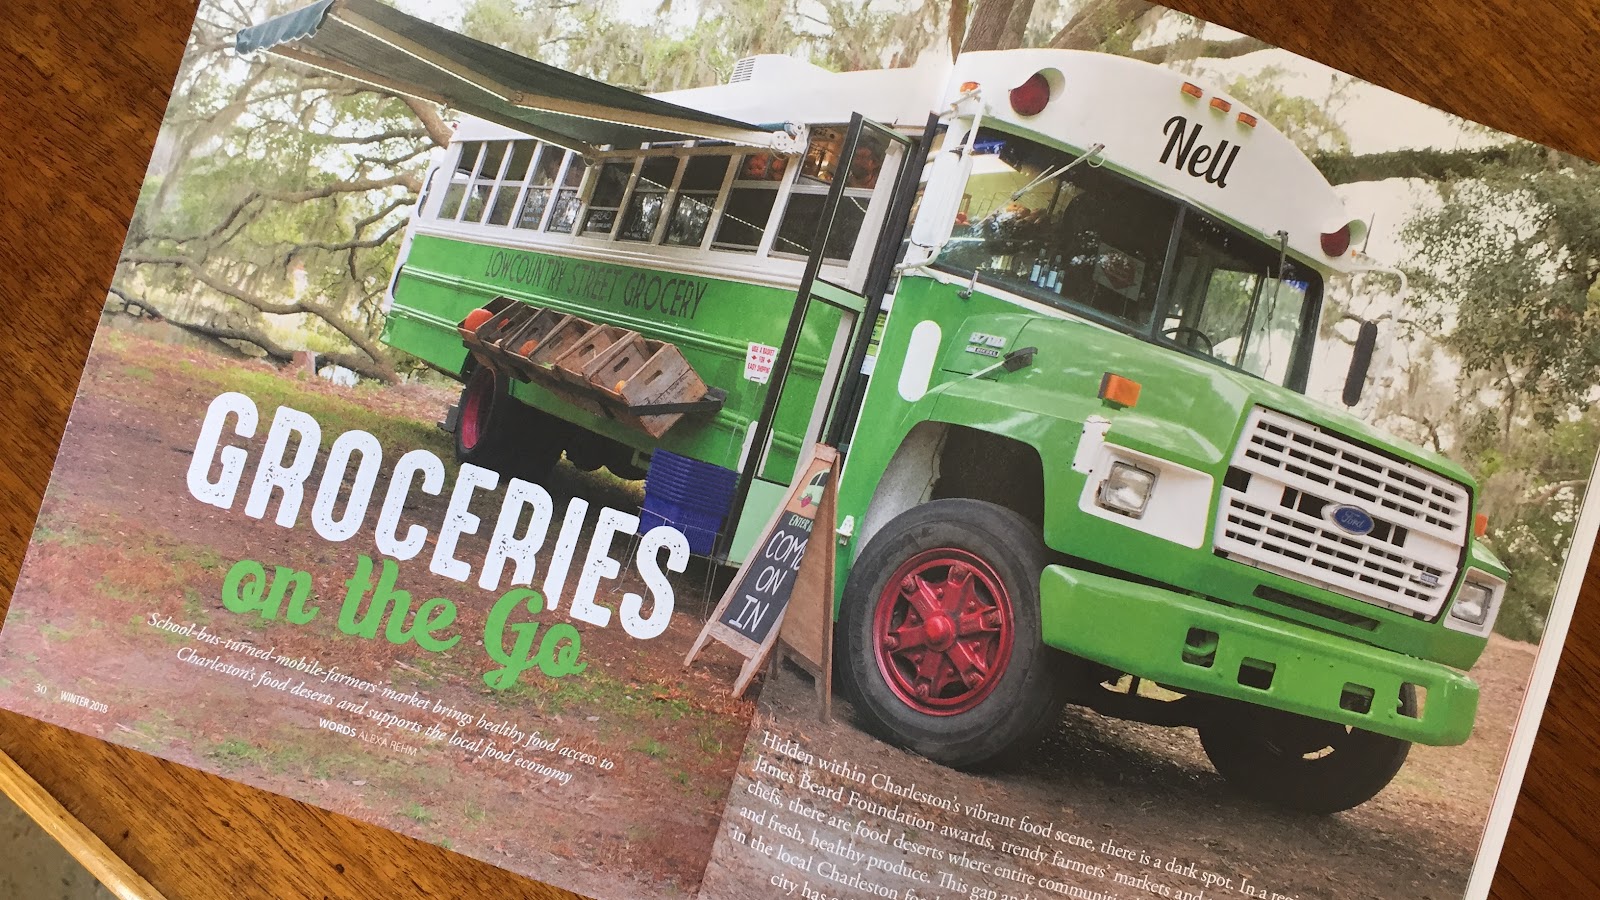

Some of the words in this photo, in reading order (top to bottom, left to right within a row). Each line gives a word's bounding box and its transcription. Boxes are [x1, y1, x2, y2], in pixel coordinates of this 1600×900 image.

[1159, 115, 1241, 189] Nell
[485, 250, 567, 292] LOWCOUNTRY
[567, 263, 623, 302] STREET
[624, 272, 708, 320] GROCERY
[186, 391, 690, 640] GROCERIES
[788, 514, 810, 530] ENTER
[1341, 509, 1365, 528] Ford
[728, 594, 769, 632] IN
[755, 565, 787, 596] ON
[221, 559, 320, 625] on
[337, 554, 462, 653] the
[483, 587, 588, 689] Go
[33, 683, 47, 695] 30
[60, 689, 90, 708] WINTER
[89, 697, 109, 713] 2018
[176, 646, 256, 682] Charleston's
[255, 671, 291, 692] food
[291, 681, 334, 706] deserts
[336, 696, 365, 716] and
[366, 707, 423, 733] supports
[424, 723, 447, 741] the
[448, 730, 482, 753] local
[478, 744, 515, 764] food
[514, 756, 573, 786] economy
[381, 684, 430, 711] market
[432, 699, 474, 727] brings
[476, 713, 525, 743] healthy
[523, 731, 559, 752] food
[558, 746, 597, 765] access
[599, 757, 614, 770] to
[318, 717, 357, 738] WORDS
[357, 730, 388, 748] ALEXA
[389, 740, 417, 757] REHM
[740, 803, 764, 826] and
[768, 813, 805, 844] fresh,
[810, 830, 865, 866] healthy
[866, 852, 931, 884] produce.
[937, 870, 969, 894] This
[969, 886, 997, 900] gap
[747, 781, 784, 808] chefs,
[788, 792, 825, 822] there
[828, 817, 851, 832] are
[852, 820, 890, 845] food
[893, 832, 943, 861] deserts
[948, 851, 991, 873] where
[994, 864, 1036, 885] entire
[752, 755, 794, 784] James
[799, 772, 845, 802] Beard
[848, 790, 935, 832] Foundation
[940, 823, 995, 850] awards,
[1001, 840, 1048, 866] trendy
[1051, 850, 1111, 879] farmers'
[1113, 872, 1171, 897] markets
[762, 730, 813, 766] Hidden
[818, 757, 866, 784] within
[871, 773, 960, 813] Charleston's
[964, 803, 1016, 828] vibrant
[1019, 815, 1053, 838] food
[1054, 829, 1096, 852] scene,
[1100, 839, 1137, 861] there
[1139, 849, 1151, 865] is
[1153, 857, 1161, 868] a
[1165, 857, 1198, 879] dark
[1200, 870, 1234, 889] spot.
[1239, 878, 1255, 896] In
[1258, 889, 1267, 900] a
[732, 825, 747, 845] in
[751, 837, 773, 855] the
[776, 844, 812, 871] local
[817, 861, 898, 900] Charleston
[770, 873, 798, 896] city
[801, 881, 827, 900] has
